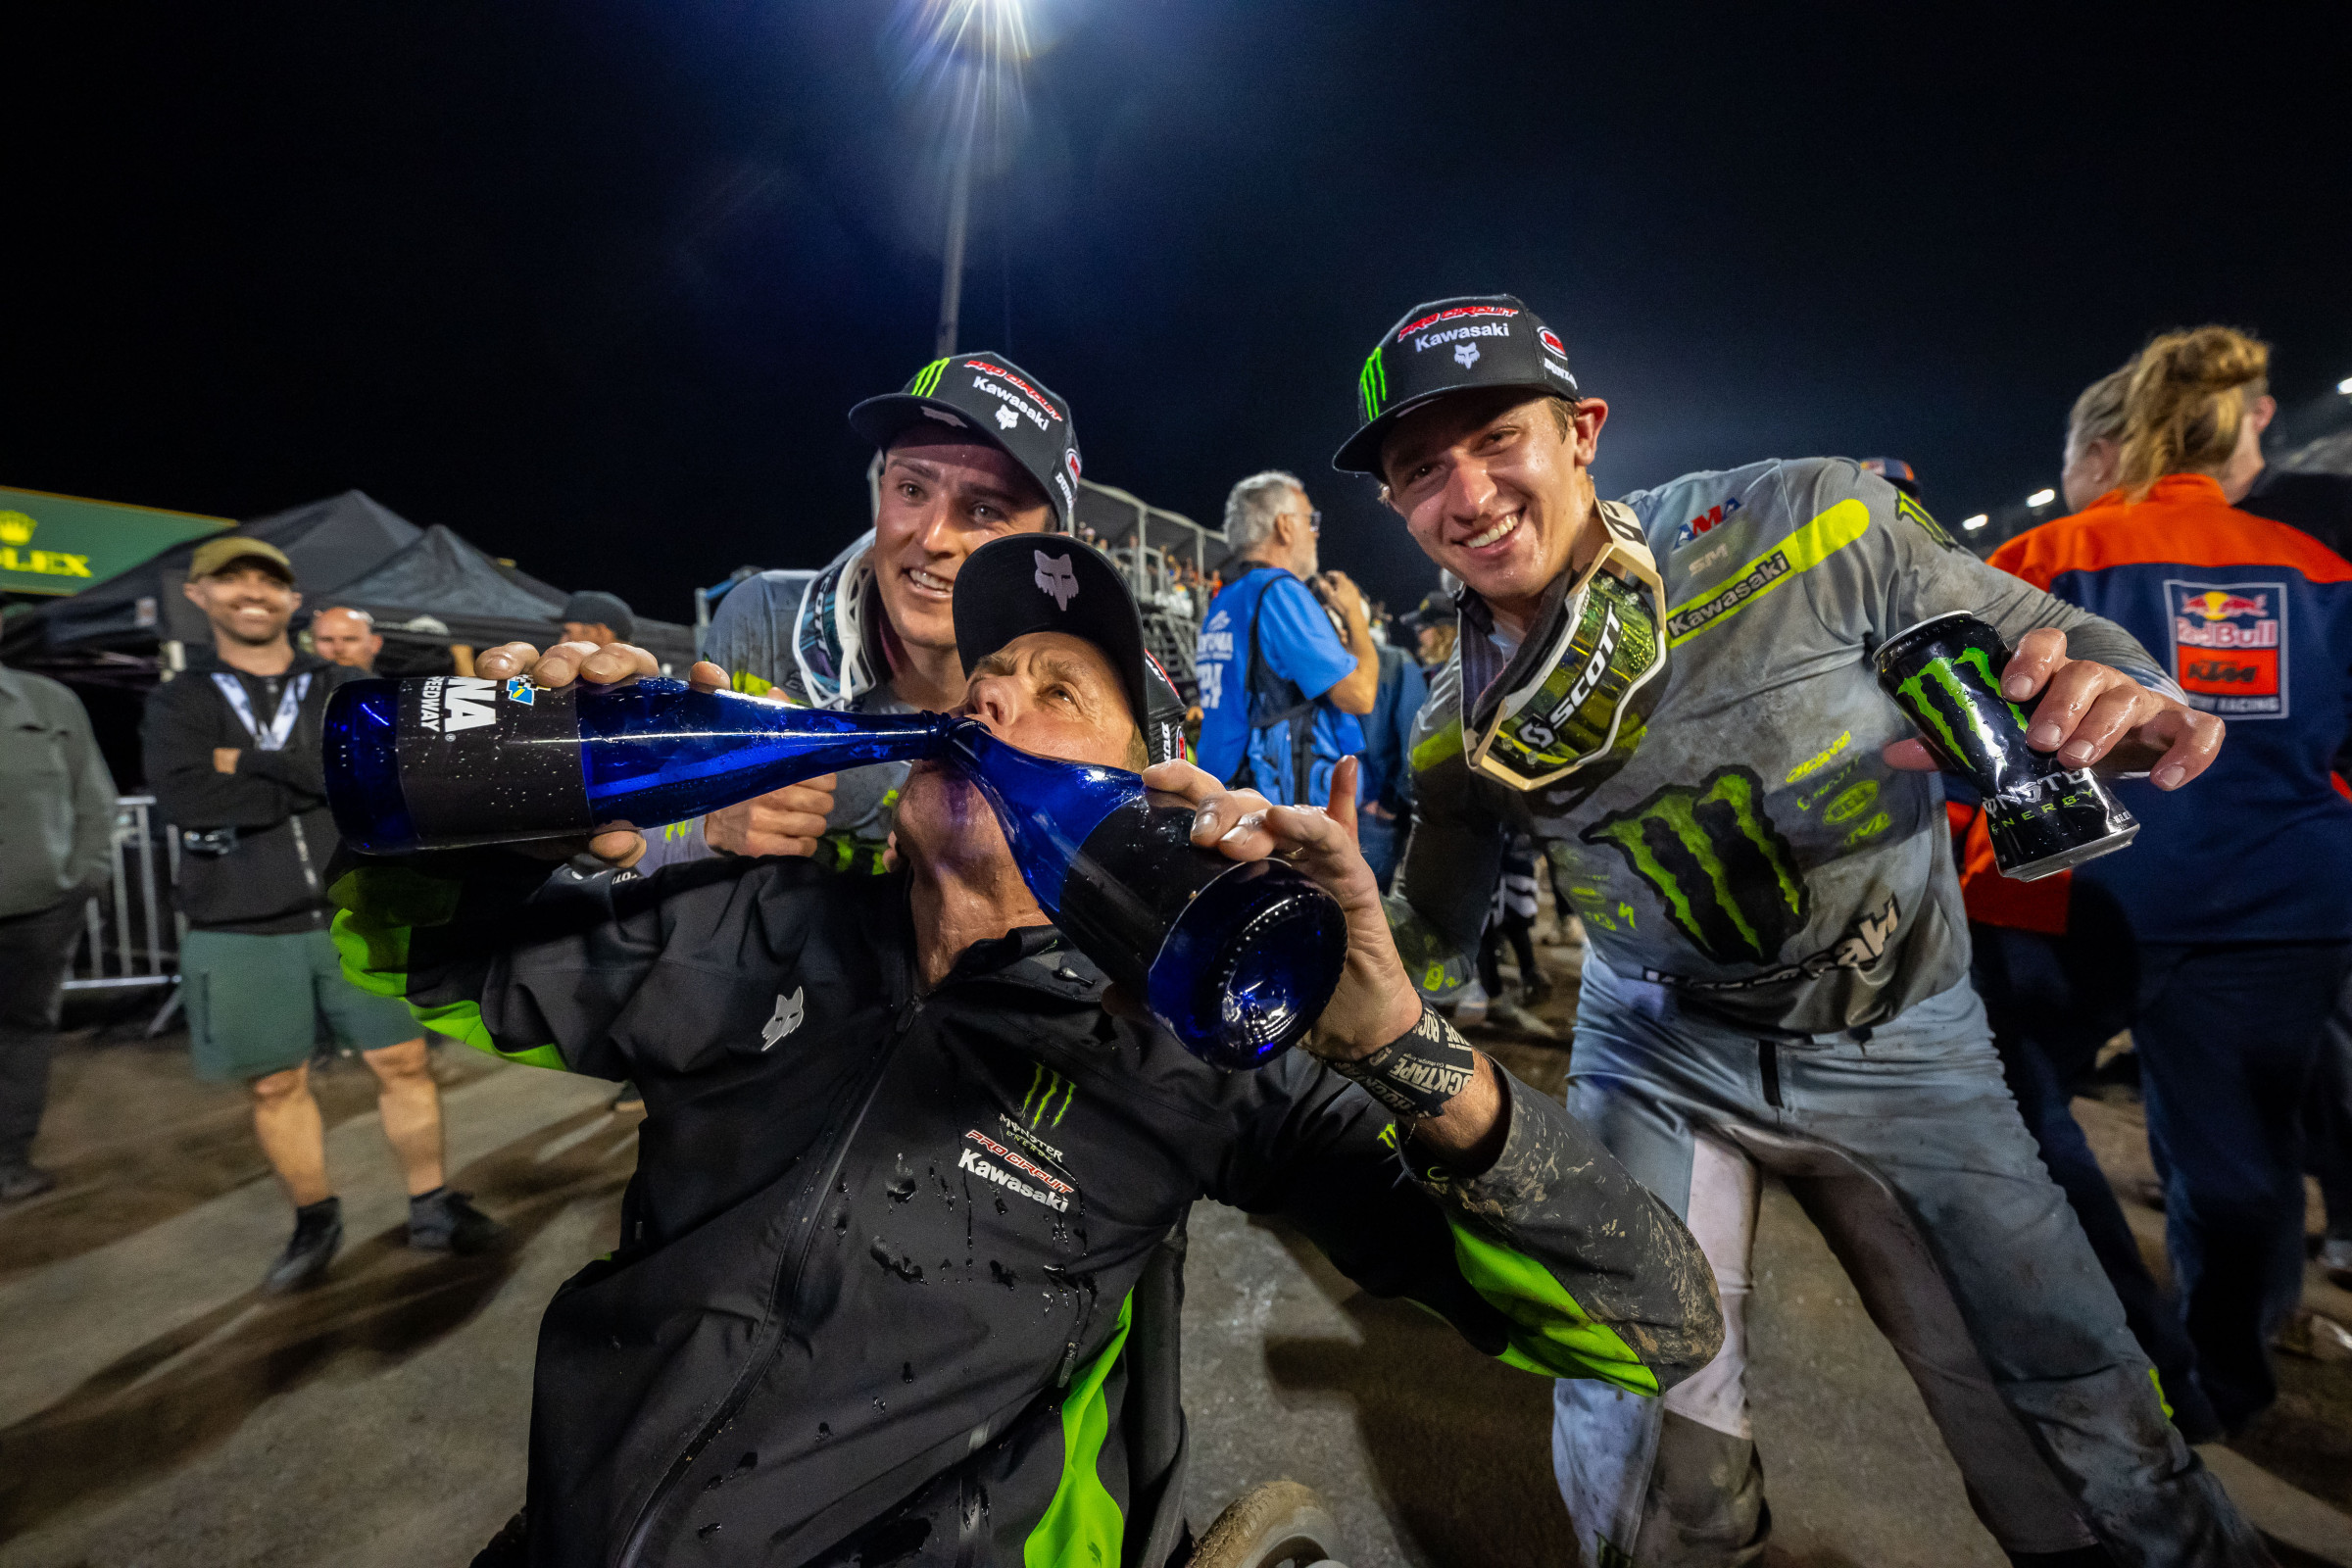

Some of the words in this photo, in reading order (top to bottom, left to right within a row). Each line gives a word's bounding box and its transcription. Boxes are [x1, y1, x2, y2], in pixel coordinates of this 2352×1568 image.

[1414, 322, 1509, 353] Kawasaki
[972, 375, 1050, 431] Kawasaki
[1671, 497, 1742, 551] AMA
[0, 546, 93, 578] LEX
[1669, 553, 1789, 637] Kawasaki
[1549, 603, 1623, 731] SCOTT
[444, 676, 498, 732] NA
[1991, 788, 2093, 835] ENERGY
[964, 1129, 1008, 1156] PRO
[1004, 1152, 1074, 1194] CIRCUIT
[1000, 1113, 1063, 1163] MONSTER
[1006, 1131, 1052, 1160] ENERGY
[957, 1149, 1069, 1213] Kawasaki
